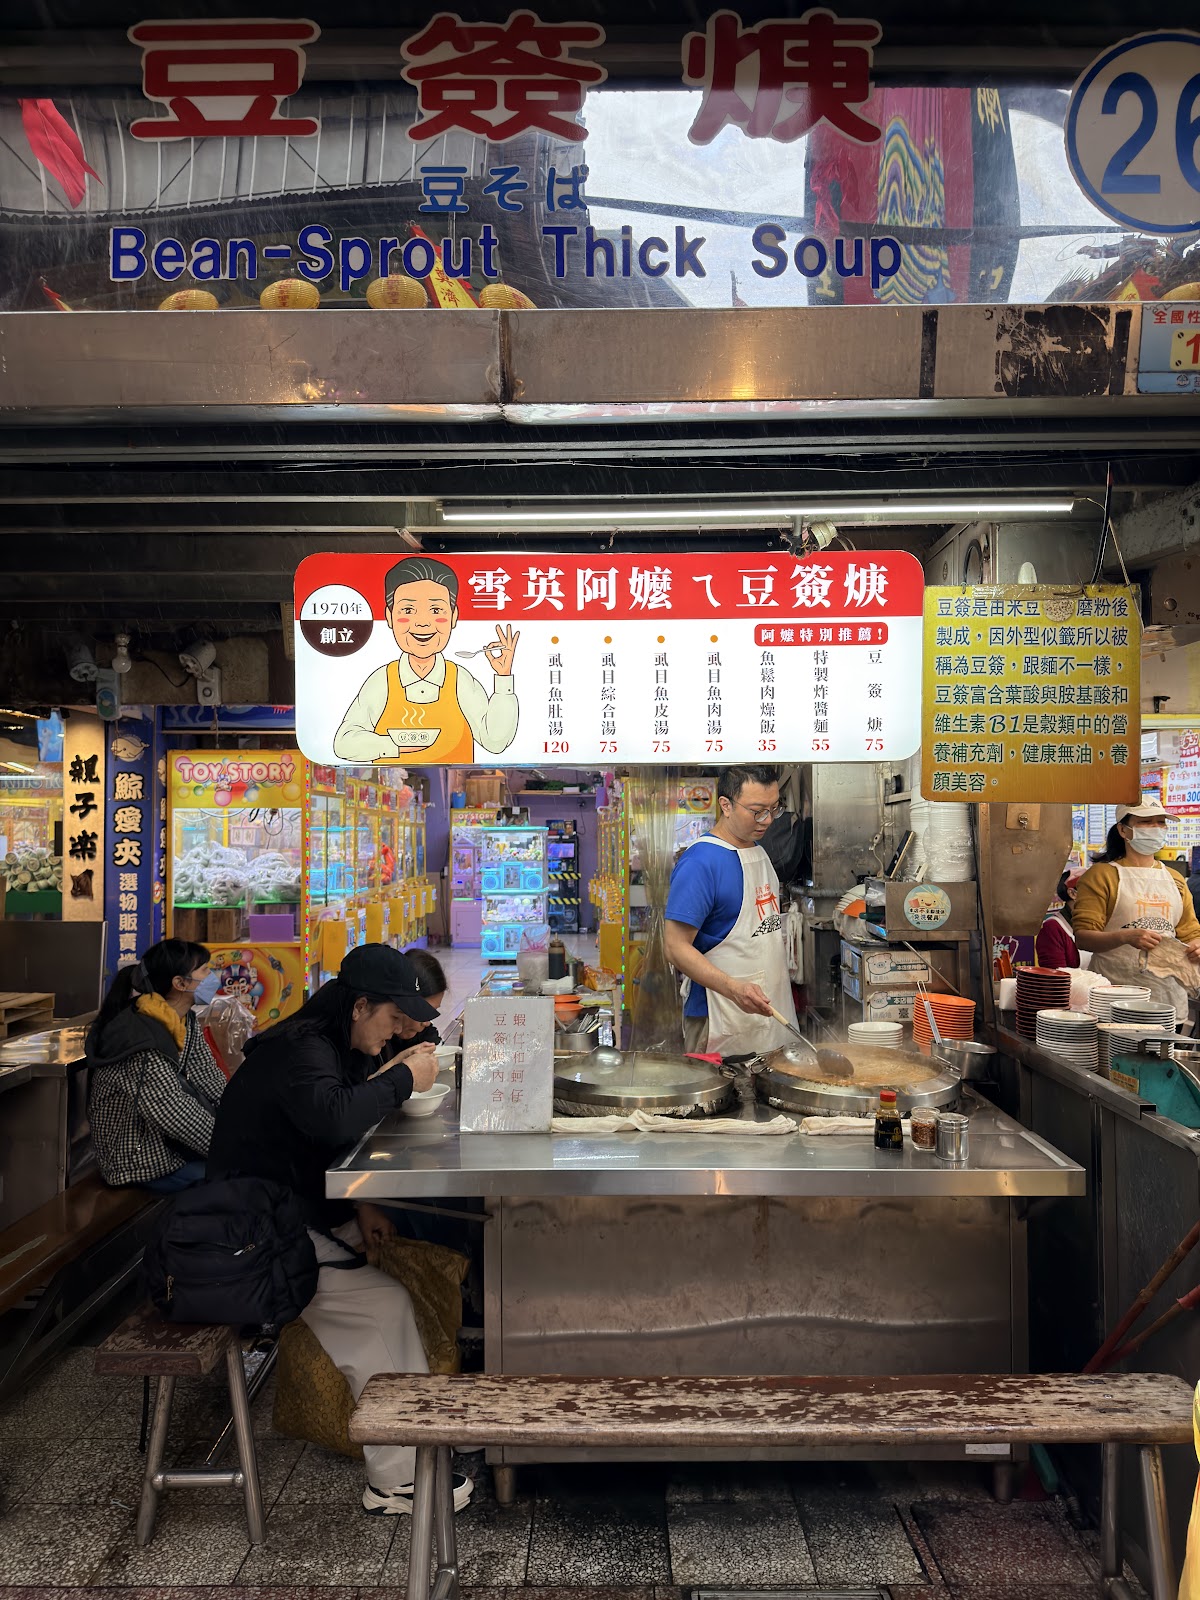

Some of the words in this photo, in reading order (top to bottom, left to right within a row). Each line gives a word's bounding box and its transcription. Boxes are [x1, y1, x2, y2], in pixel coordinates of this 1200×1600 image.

[418, 165, 588, 213] 豆そば
[111, 225, 498, 290] Bean-Sprout
[542, 225, 706, 279] Thick
[752, 224, 901, 288] Soup
[312, 602, 362, 615] 1970年
[320, 627, 354, 644] 創立
[548, 652, 564, 735] 虱目魚肚湯
[601, 652, 616, 735] 虱目綜合湯
[654, 652, 669, 735] 虱目魚皮湯
[707, 652, 722, 734] 虱目魚肉湯
[760, 651, 775, 734] 魚鬆肉燥飯
[542, 741, 569, 753] 120
[600, 741, 617, 753] 75
[653, 741, 670, 753] 75
[705, 740, 723, 752] 75
[758, 739, 776, 751] 35
[811, 739, 829, 751] 55
[865, 739, 883, 751] 75
[180, 762, 222, 783] TOY
[226, 762, 295, 783] STORY
[114, 773, 142, 867] 鯨愛夾
